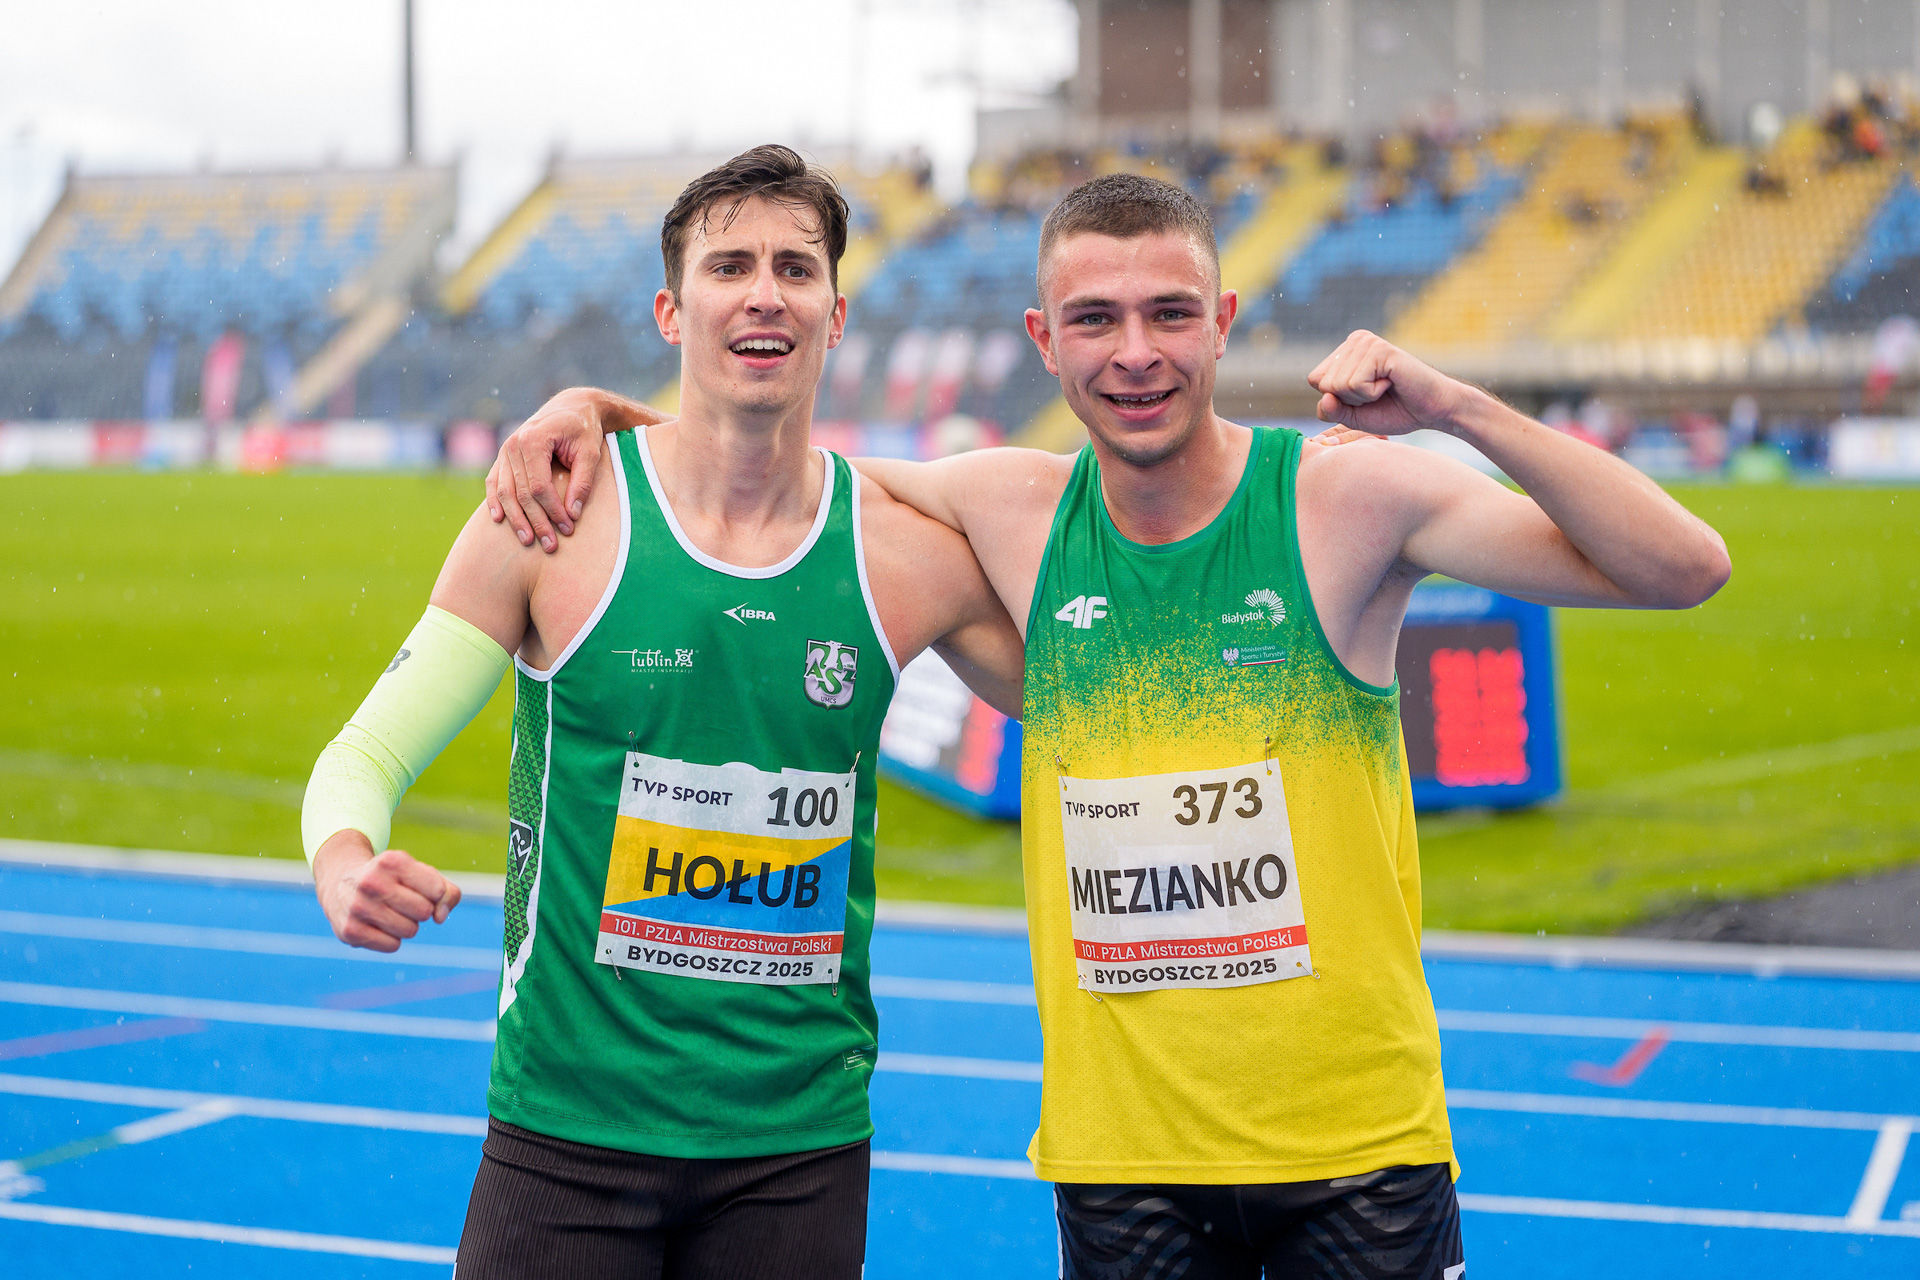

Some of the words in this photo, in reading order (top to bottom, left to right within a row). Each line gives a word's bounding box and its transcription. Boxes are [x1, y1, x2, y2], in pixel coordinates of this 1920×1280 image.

[1055, 595, 1108, 629] 4F
[1240, 645, 1276, 653] Ministerstwo
[804, 657, 857, 695] ASZ
[820, 696, 837, 704] UMCS
[631, 777, 668, 797] TVP
[672, 786, 733, 806] SPORT
[767, 786, 838, 827] 100
[1172, 777, 1263, 826] 373
[1065, 801, 1086, 818] TVP
[1088, 802, 1141, 819] SPORT
[643, 847, 821, 909] HOŁUB
[1071, 853, 1288, 915] MIEZIANKO
[614, 918, 640, 937] 101.
[645, 926, 684, 943] PZLA
[689, 932, 788, 953] Mistrzostwa
[792, 937, 832, 953] Polski
[1081, 943, 1099, 959] 101.
[1101, 945, 1137, 961] PZLA
[1140, 939, 1239, 958] Mistrzostwa
[1243, 930, 1293, 952] Polski
[627, 945, 762, 976] BYDGOSZCZ
[766, 961, 814, 977] 2025
[1095, 965, 1218, 985] BYDGOSZCZ
[1222, 958, 1278, 980] 2025
